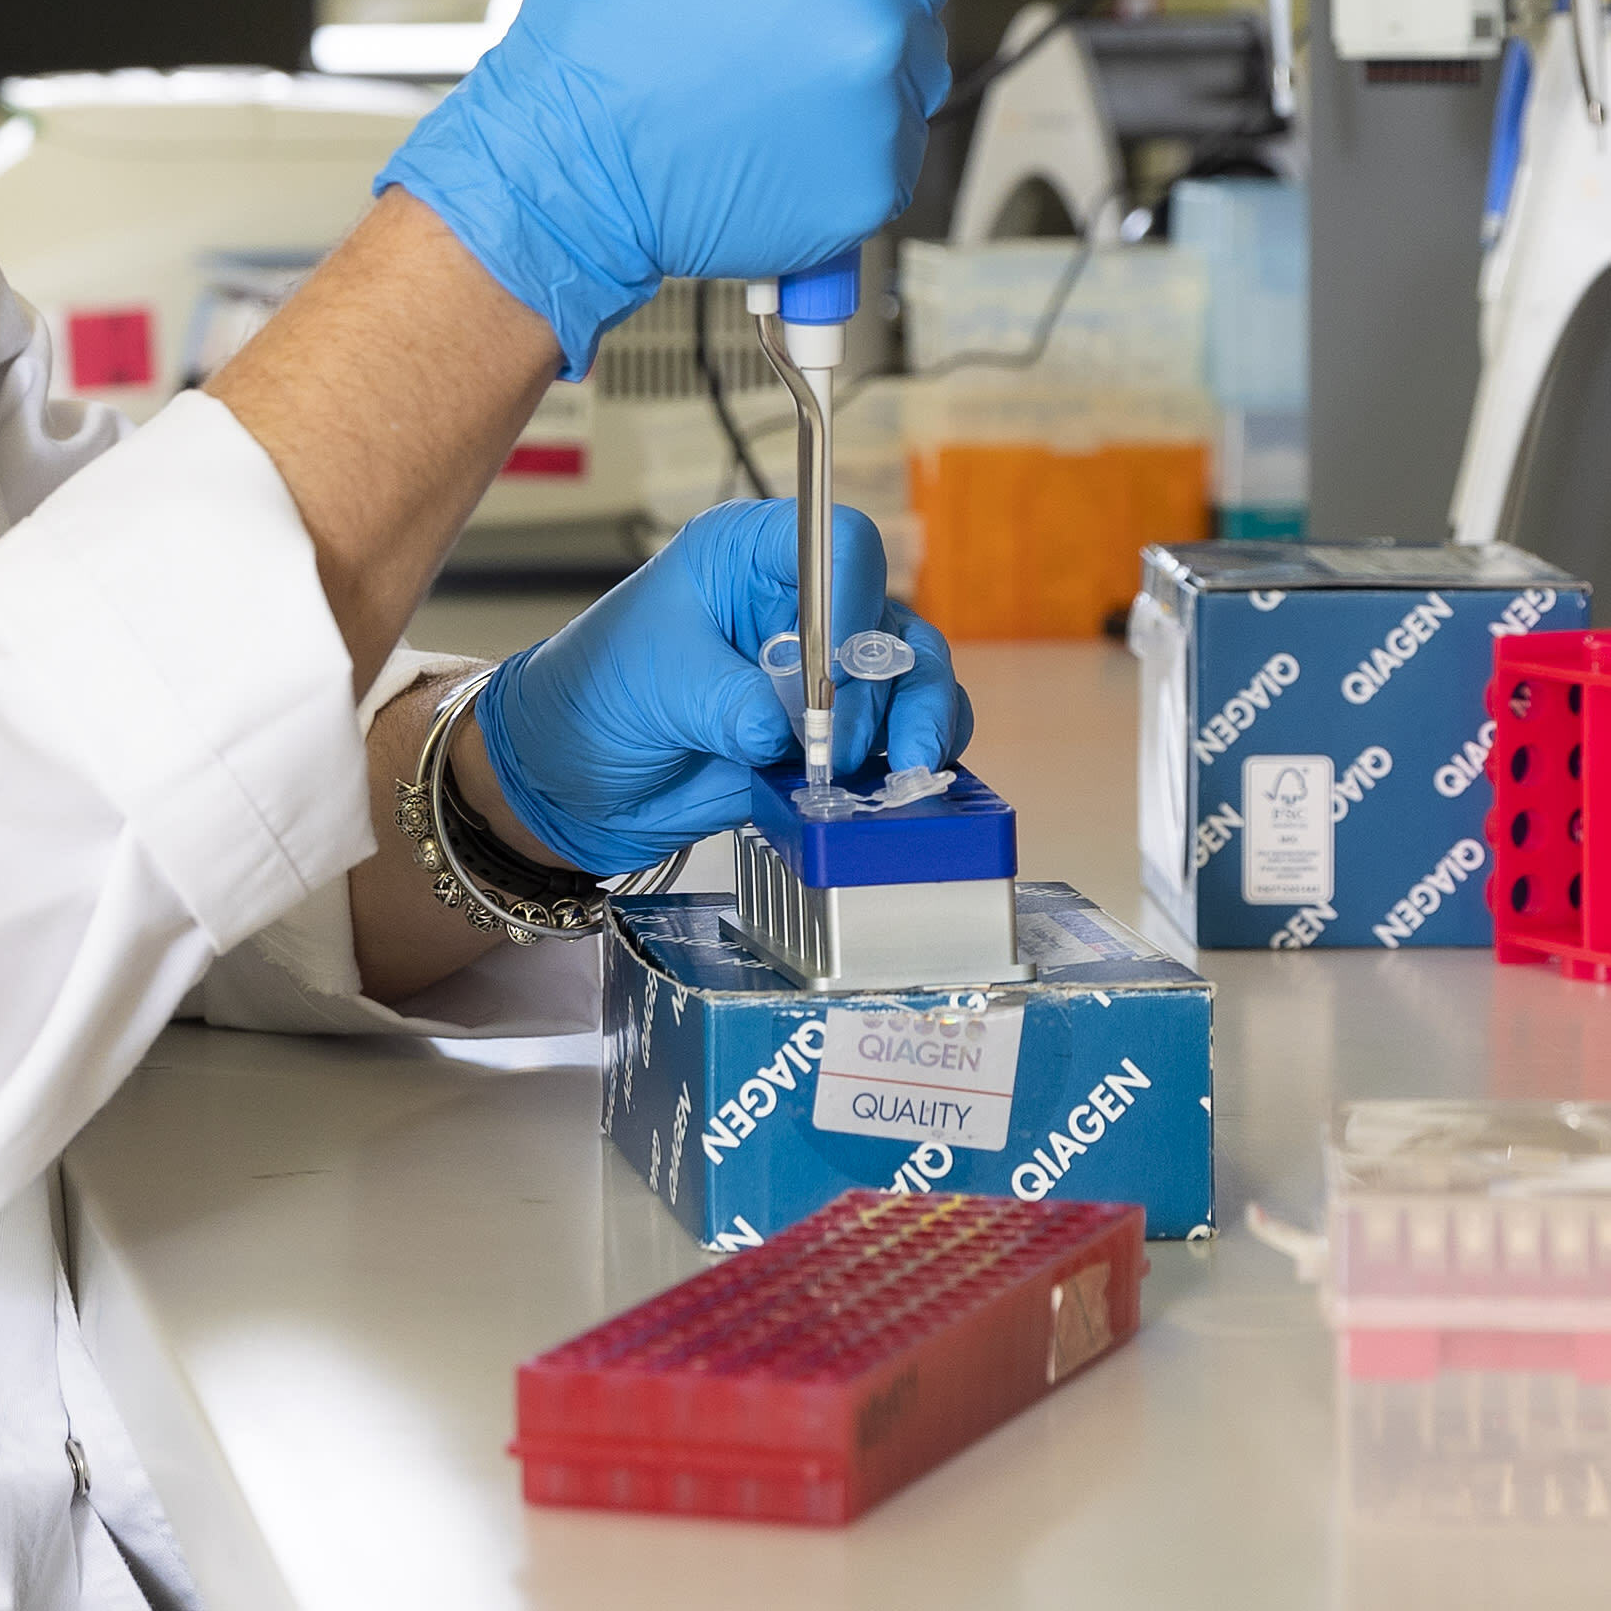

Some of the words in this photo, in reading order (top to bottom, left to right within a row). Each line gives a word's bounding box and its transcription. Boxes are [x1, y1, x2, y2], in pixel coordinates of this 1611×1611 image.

[1341, 591, 1454, 706] QIAGEN
[1194, 652, 1301, 766] QIAGEN
[1372, 838, 1486, 950] QIAGEN
[701, 1019, 828, 1166] QIAGEN
[857, 1033, 983, 1073] QIAGEN
[852, 1092, 973, 1131] QUALITY
[1011, 1056, 1152, 1203] QIAGEN
